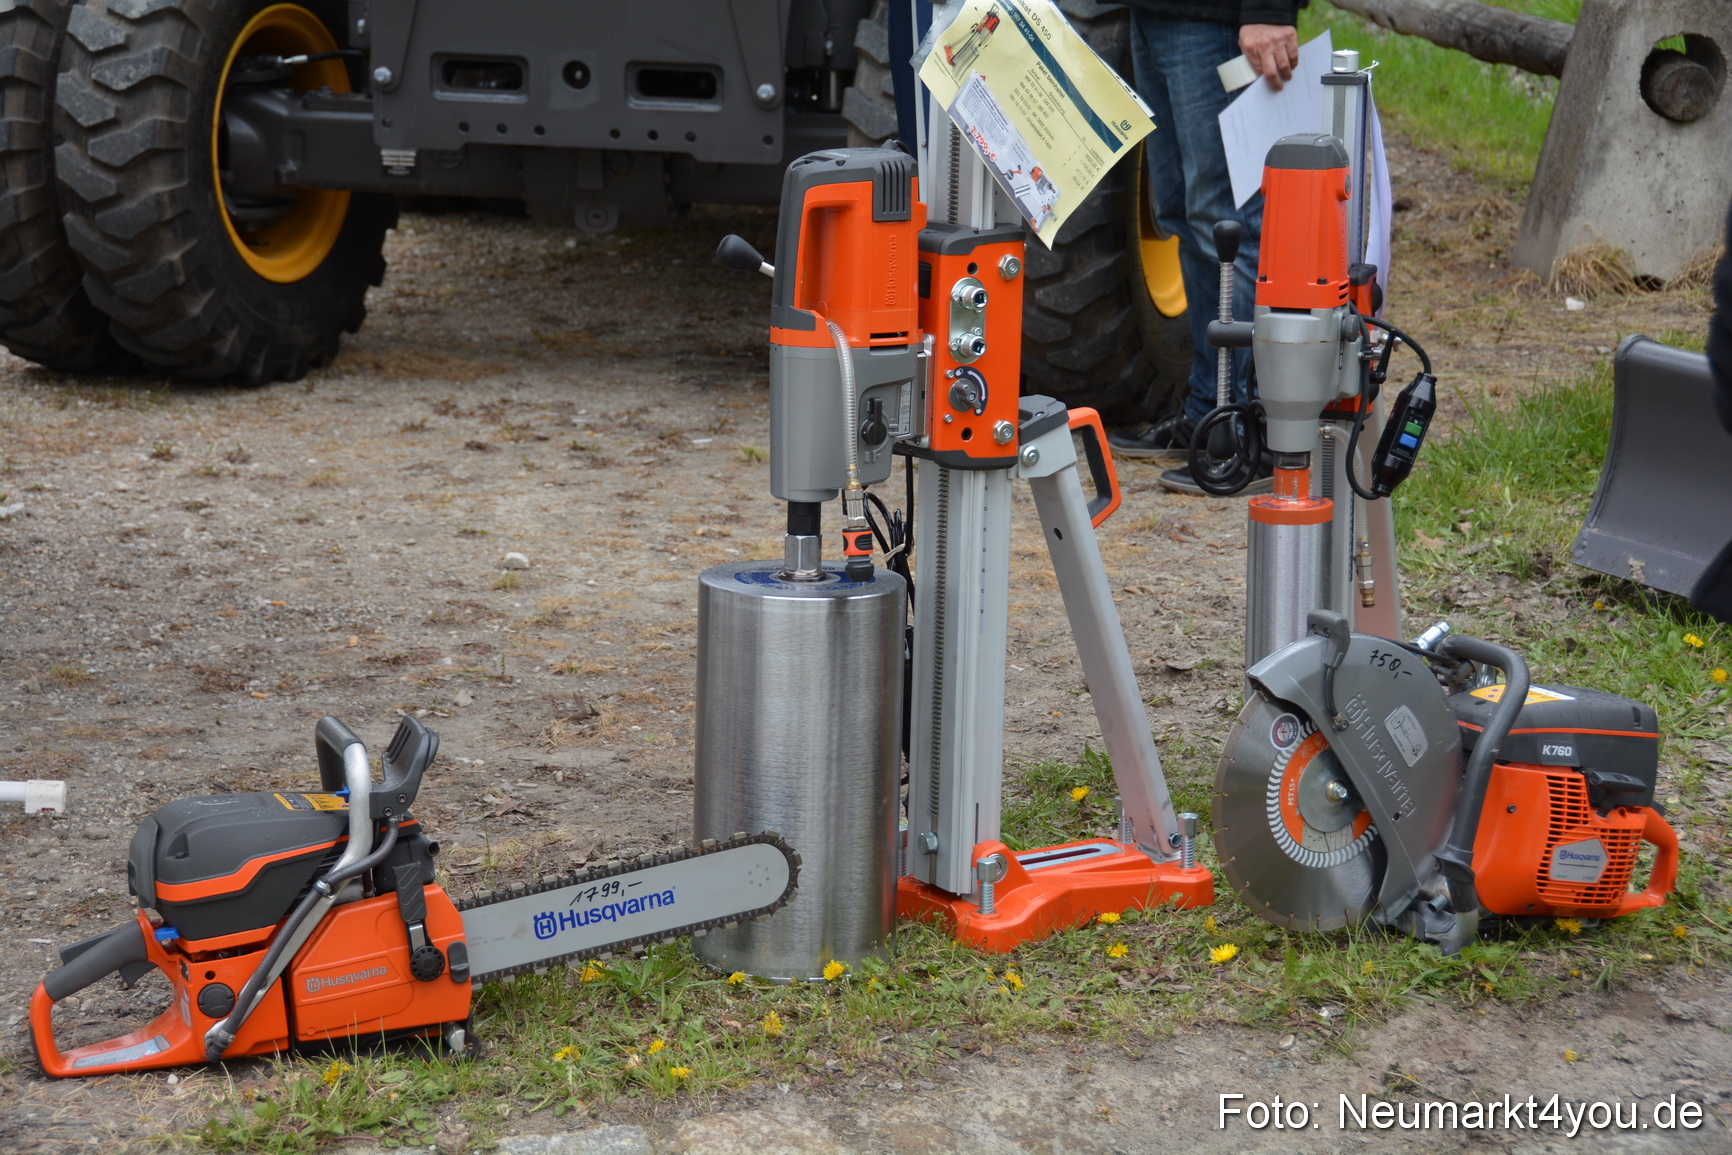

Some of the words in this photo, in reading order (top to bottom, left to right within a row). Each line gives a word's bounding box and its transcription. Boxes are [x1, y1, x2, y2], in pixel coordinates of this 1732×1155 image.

[1017, 20, 1025, 28] 34
[1029, 12, 1043, 26] DS
[1038, 25, 1053, 40] 450
[1035, 61, 1048, 75] Paket
[1045, 74, 1066, 98] beinhaltet
[1110, 120, 1128, 141] Husqvarna
[887, 235, 897, 293] Husqvarna
[1369, 649, 1412, 679] 750,-
[1542, 745, 1572, 757] K760
[1356, 715, 1416, 818] Husqvarna
[1287, 778, 1296, 806] MT15+
[1567, 852, 1600, 862] Husqvarna
[570, 880, 643, 906] 1799,-
[558, 889, 675, 932] Husqvarna
[321, 966, 387, 988] Husqvarna
